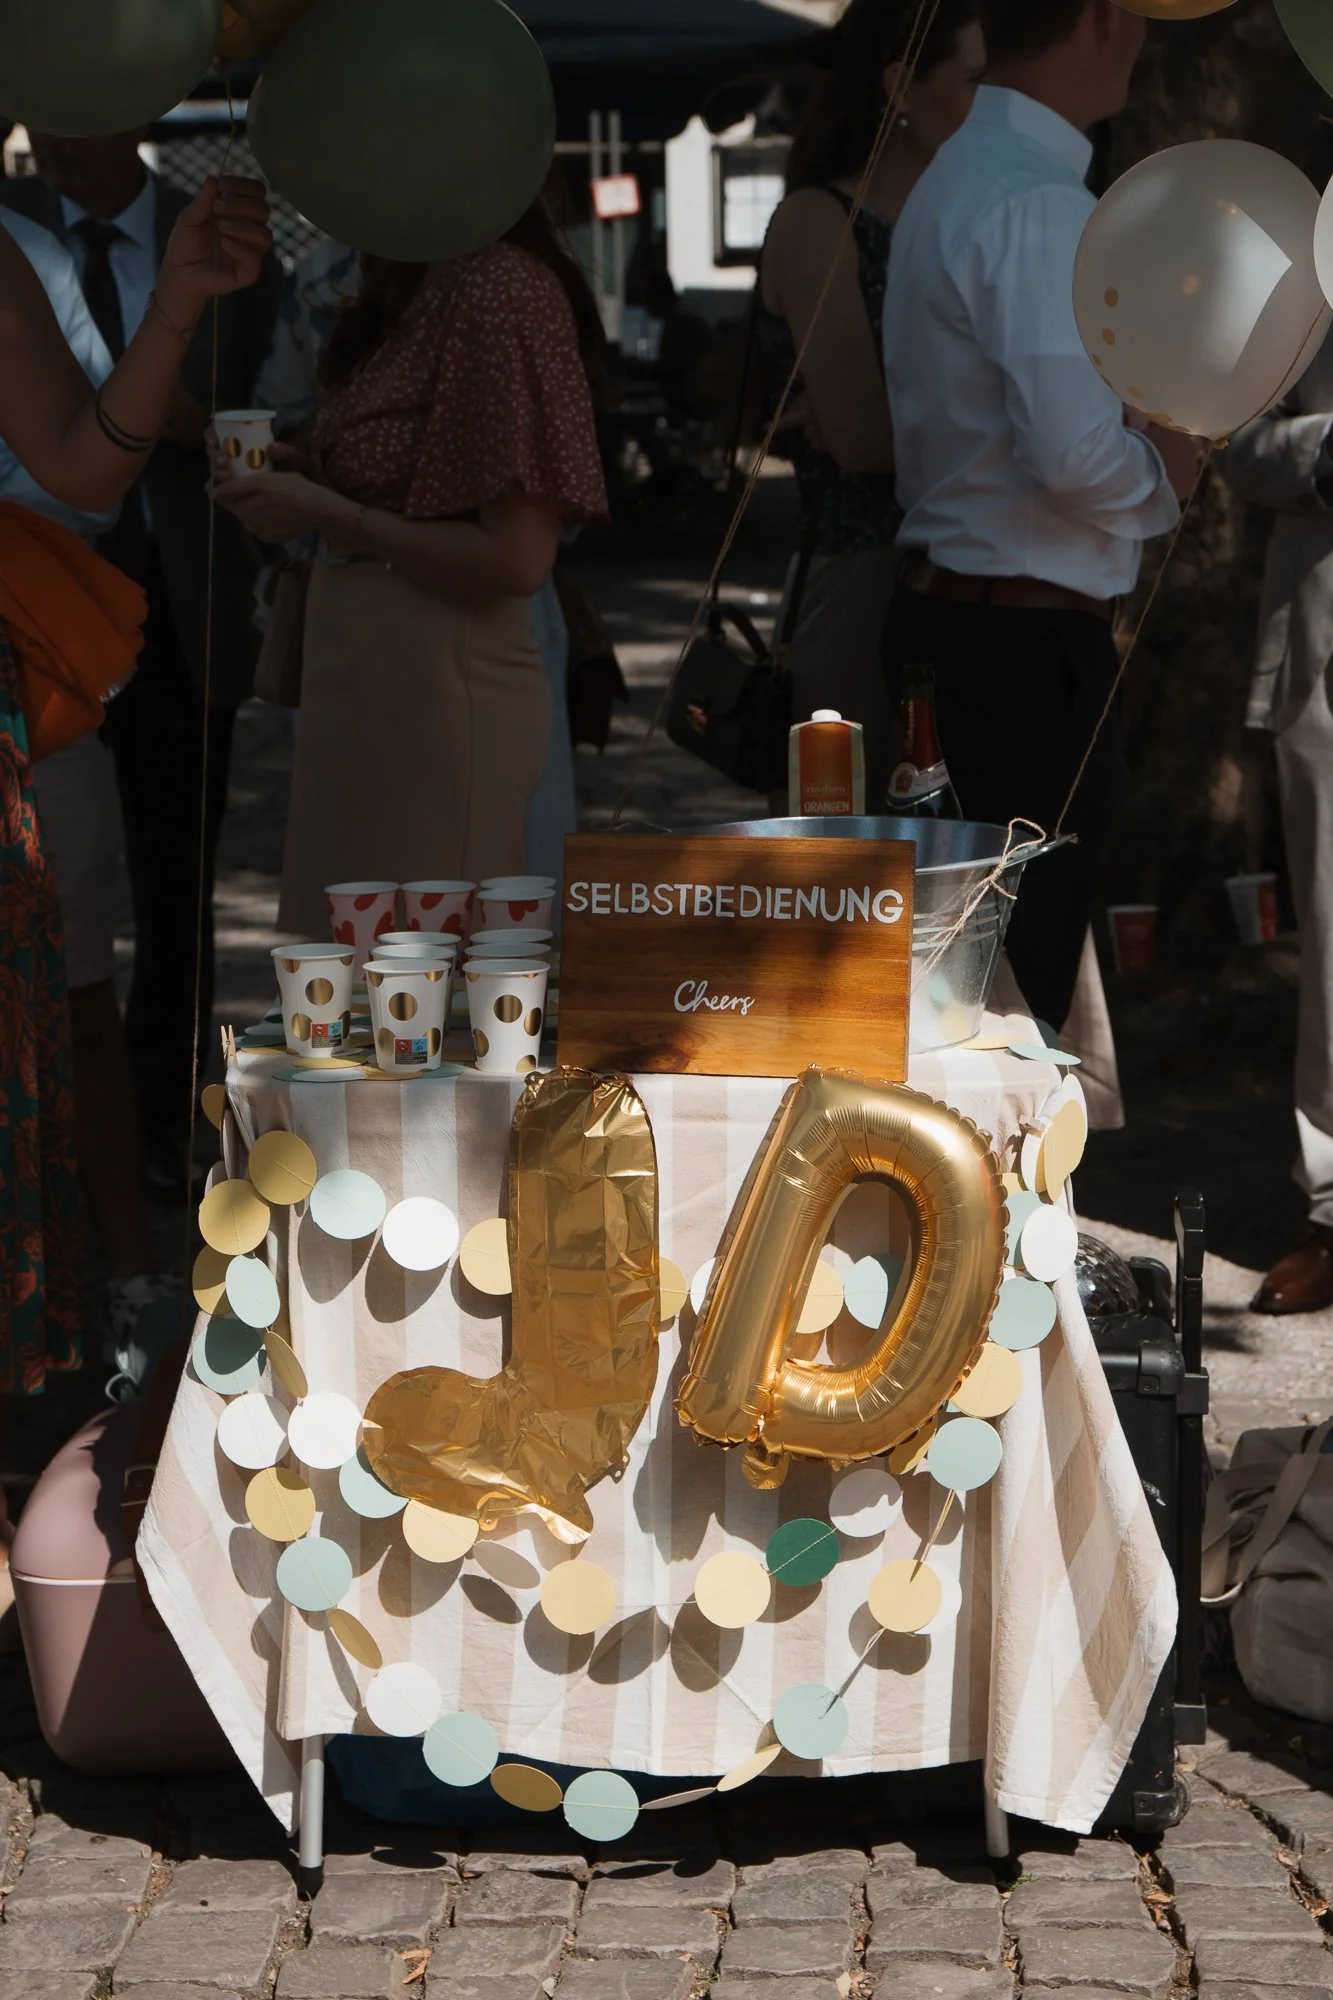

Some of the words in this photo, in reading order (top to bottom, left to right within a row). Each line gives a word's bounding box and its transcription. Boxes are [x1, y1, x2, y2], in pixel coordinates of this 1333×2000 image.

[803, 800, 850, 813] ORANGEN
[566, 881, 904, 924] SELBSTBEDIENUNG
[673, 979, 755, 1015] Cheers
